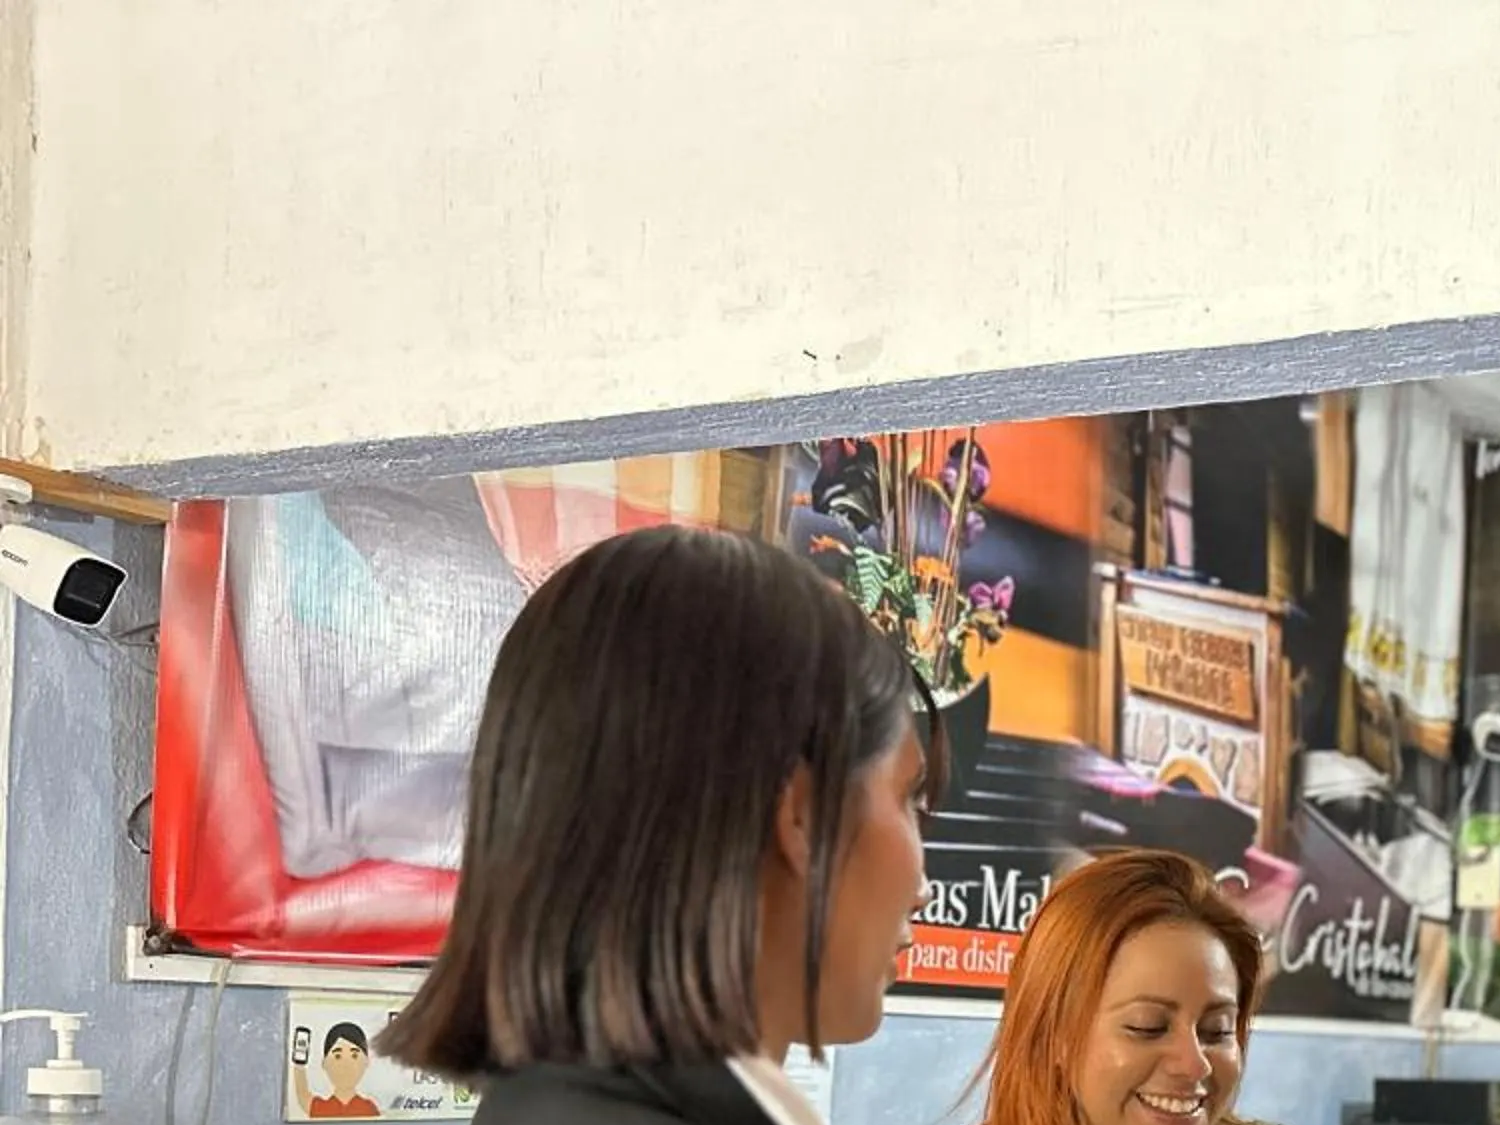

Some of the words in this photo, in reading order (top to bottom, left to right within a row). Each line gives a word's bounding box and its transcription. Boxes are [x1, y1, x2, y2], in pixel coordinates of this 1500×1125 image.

[909, 879, 968, 927] as
[905, 942, 959, 981] para
[403, 1096, 442, 1109] telcel
